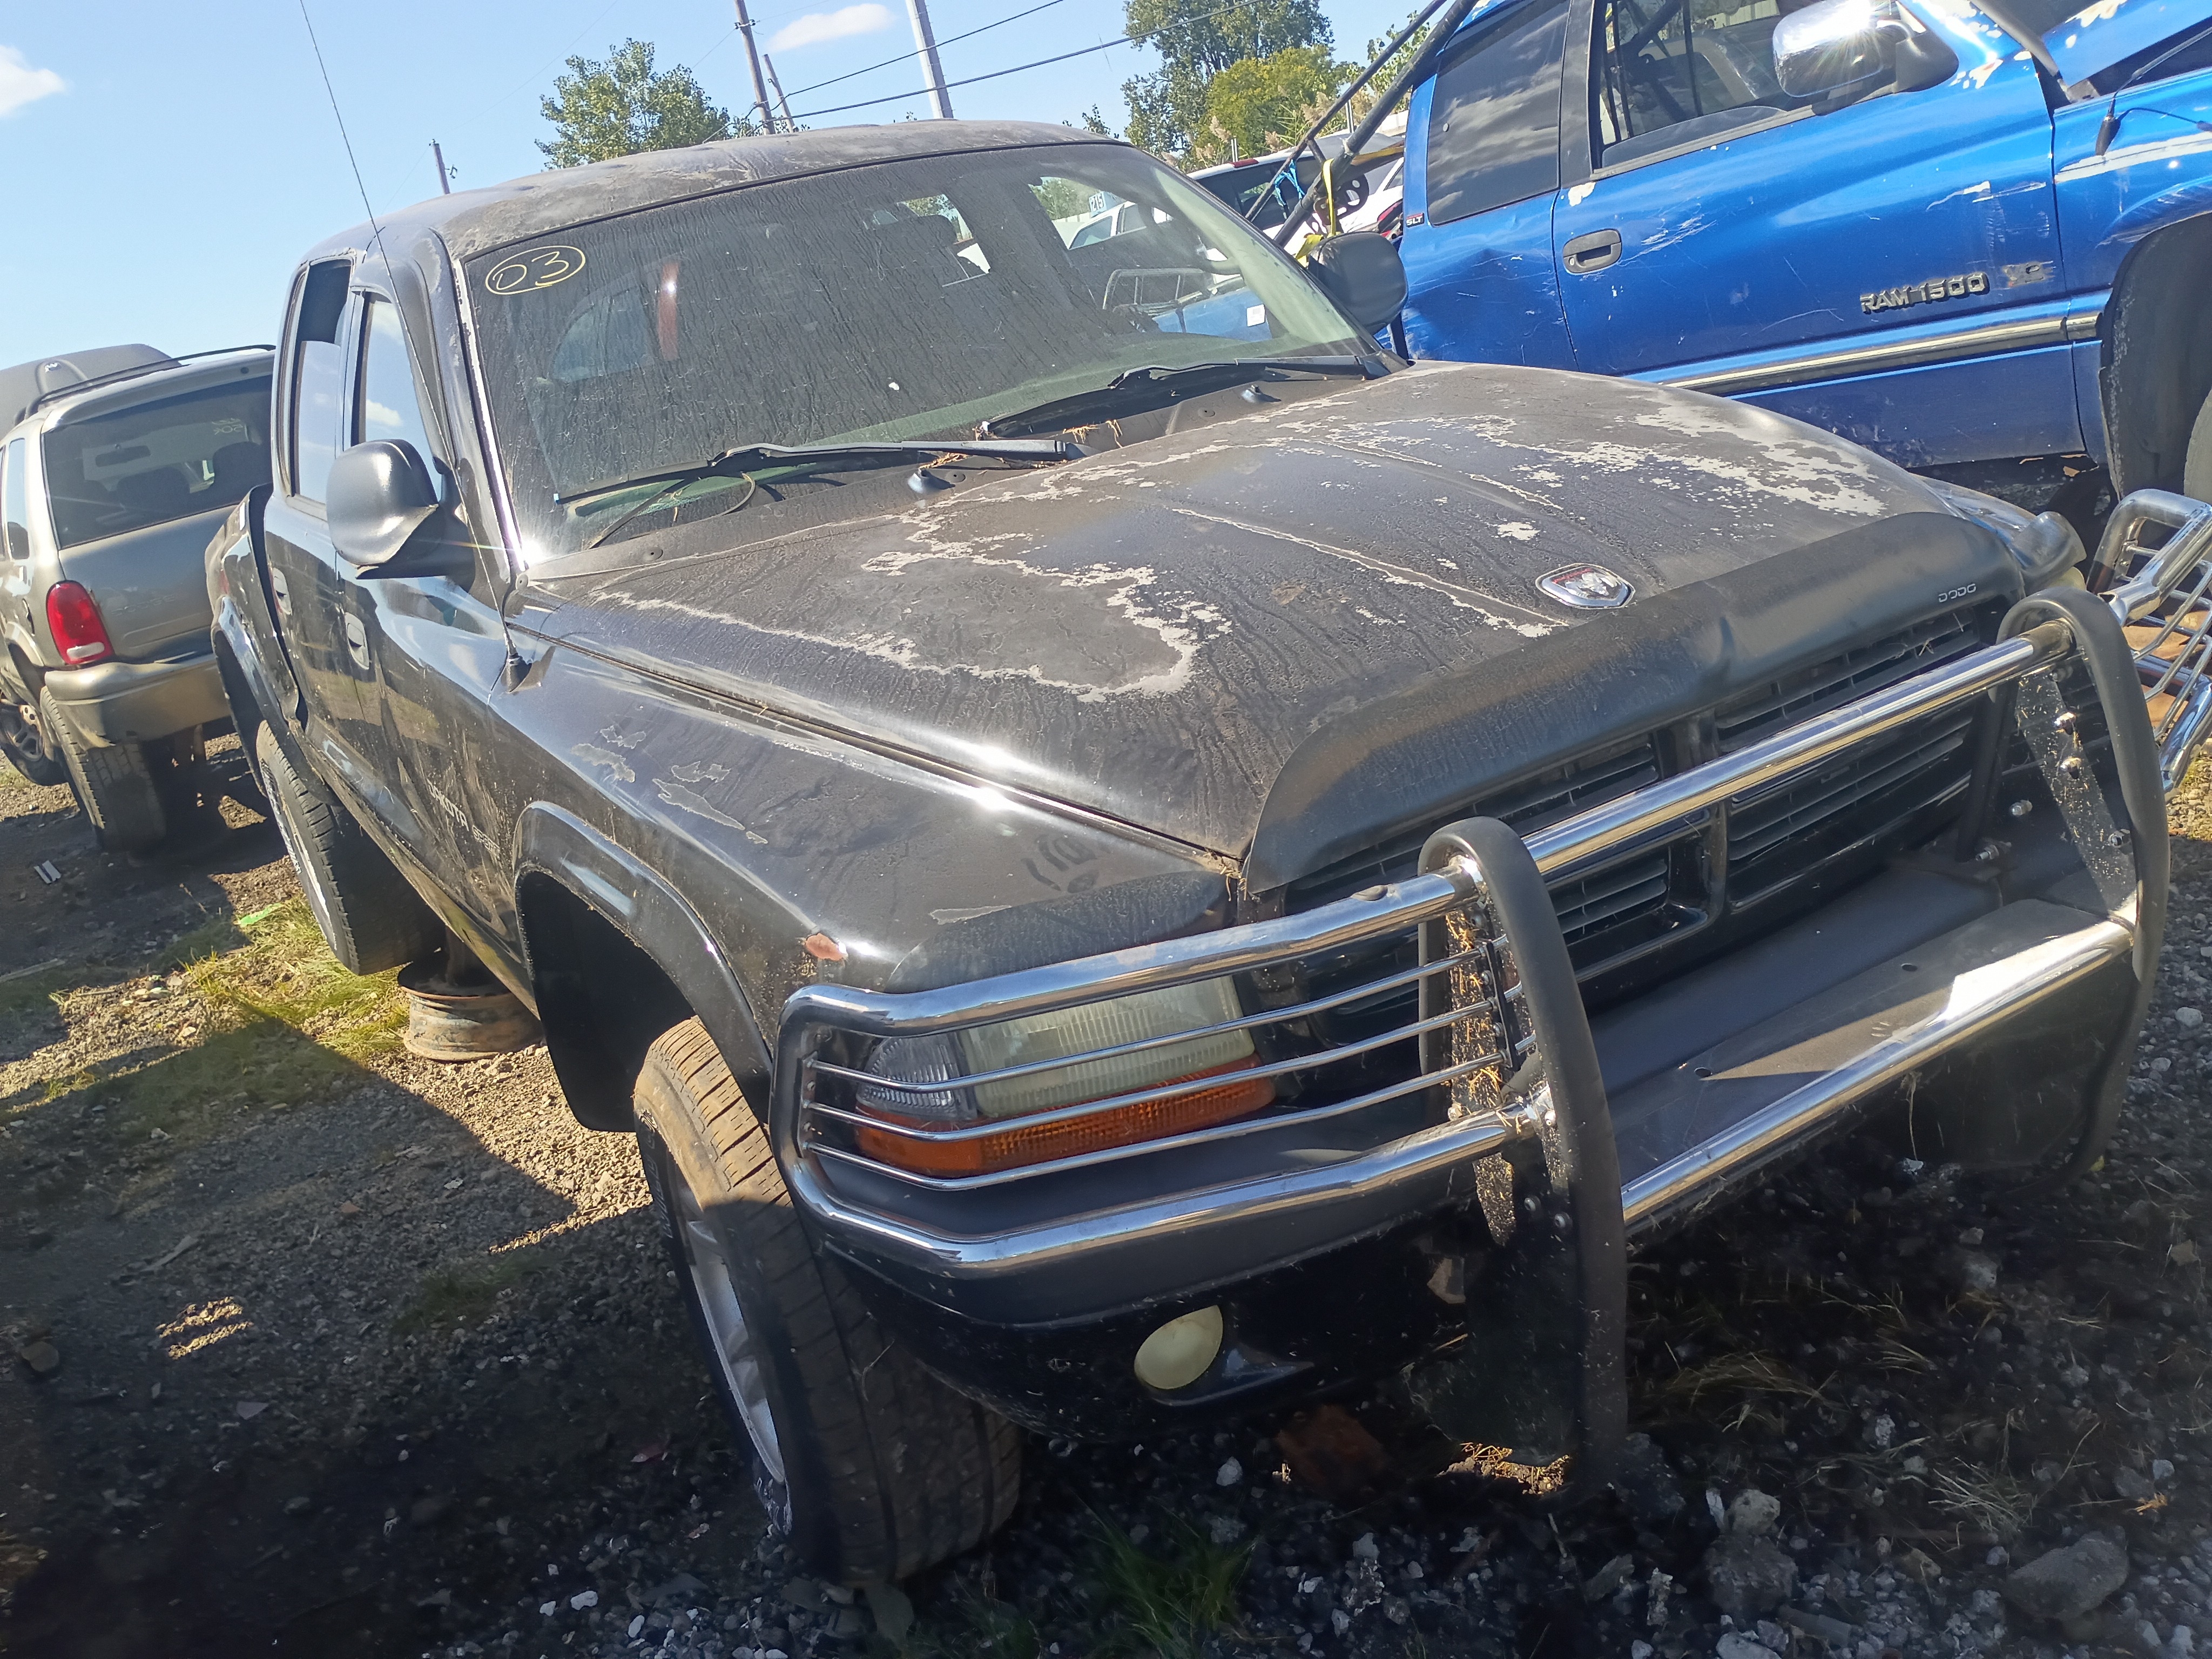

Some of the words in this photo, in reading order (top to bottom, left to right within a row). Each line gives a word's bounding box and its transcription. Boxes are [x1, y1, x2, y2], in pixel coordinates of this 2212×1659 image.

[1090, 193, 1104, 213] 215
[1406, 215, 1423, 226] SLT
[1860, 286, 1912, 315] RAM
[1918, 272, 1990, 304] 1500
[427, 778, 469, 832] DAKOTA
